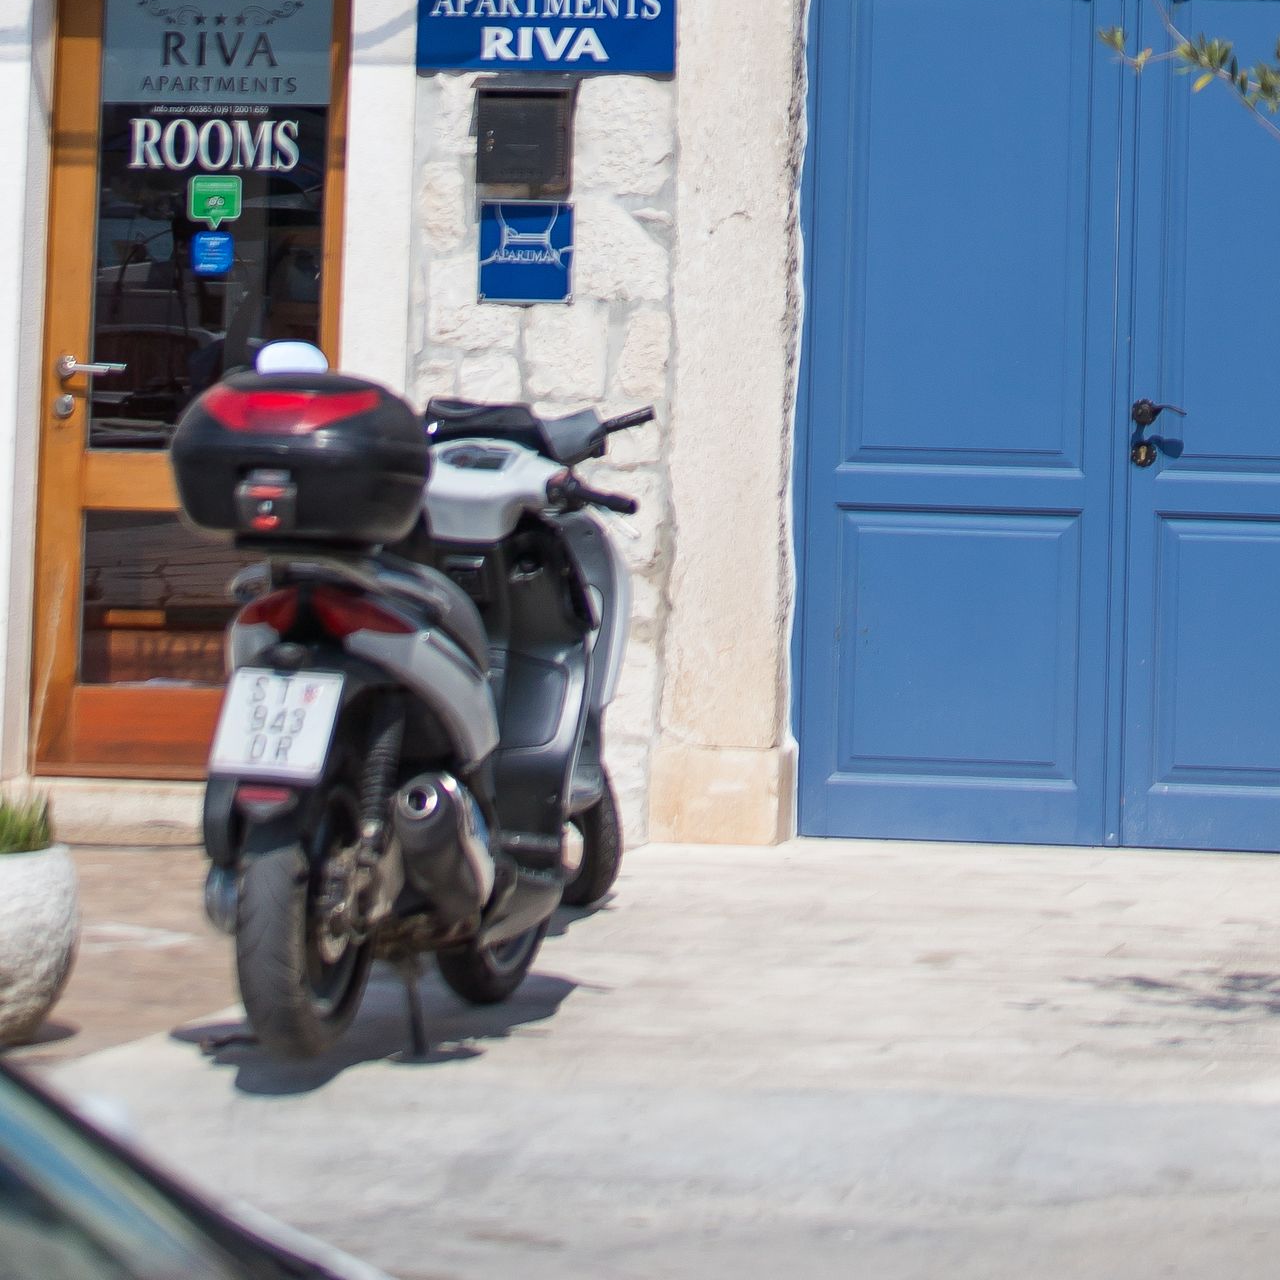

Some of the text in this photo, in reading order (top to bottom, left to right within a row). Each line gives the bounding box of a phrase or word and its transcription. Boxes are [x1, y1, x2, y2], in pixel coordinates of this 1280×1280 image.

[162, 31, 280, 67] RIVA
[480, 26, 610, 62] RIVA
[141, 75, 298, 93] APARTMENTS
[130, 118, 299, 171] ROOMS
[250, 705, 306, 734] 943
